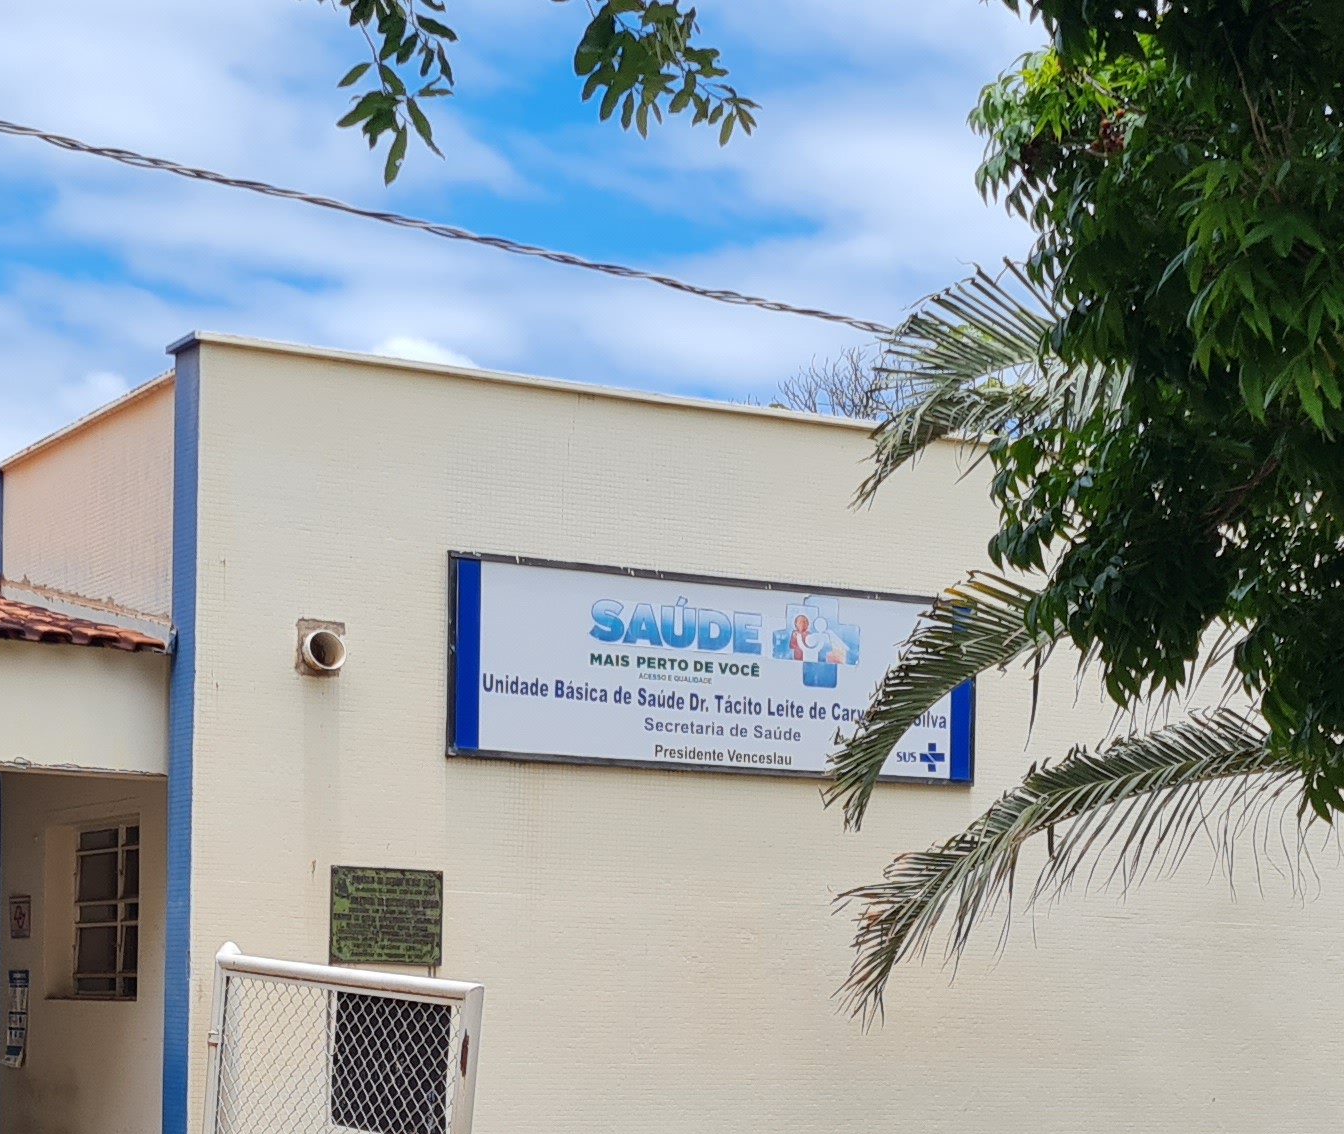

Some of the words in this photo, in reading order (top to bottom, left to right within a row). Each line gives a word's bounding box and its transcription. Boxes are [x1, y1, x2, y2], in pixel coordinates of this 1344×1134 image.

[589, 596, 761, 656] SAÚDE
[590, 653, 630, 667] MAIS
[636, 656, 689, 671] PERTO
[693, 661, 714, 673] DE
[718, 662, 761, 678] VOCÊ
[482, 673, 549, 698] Unidade
[554, 679, 608, 703] Básica
[614, 686, 632, 705] de
[637, 687, 685, 710] Saúde
[689, 693, 709, 712] Dr.
[714, 694, 762, 715] Tácito
[767, 698, 805, 719] Leite
[809, 701, 827, 720] de
[644, 717, 724, 736] Secretaria
[730, 723, 748, 738] de
[753, 725, 801, 742] Saúde
[654, 744, 724, 762] Presidente
[727, 748, 792, 765] Venceslau
[896, 752, 917, 763] SUS
